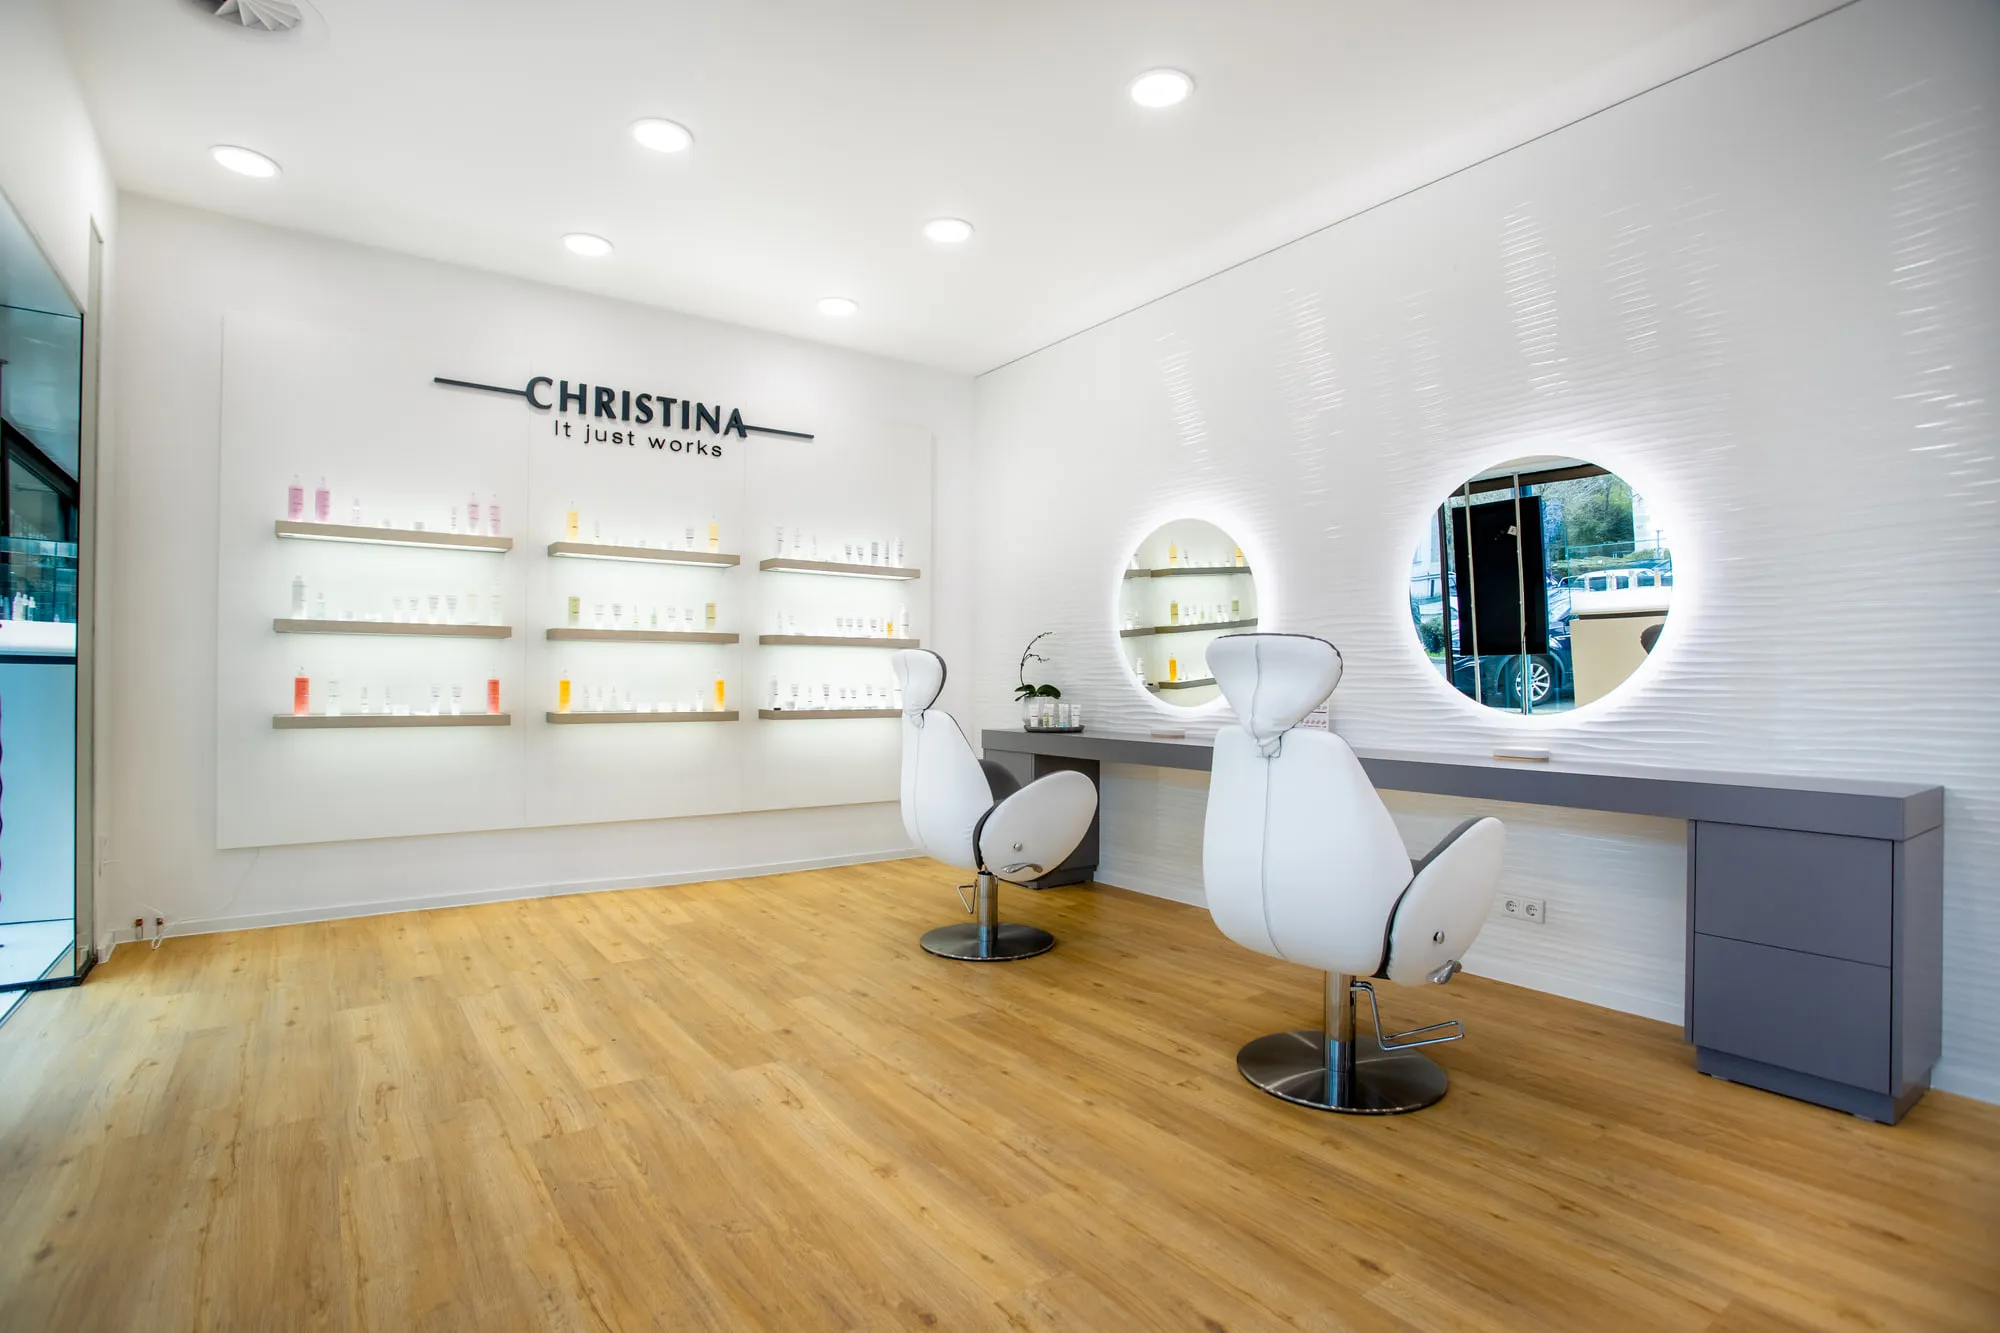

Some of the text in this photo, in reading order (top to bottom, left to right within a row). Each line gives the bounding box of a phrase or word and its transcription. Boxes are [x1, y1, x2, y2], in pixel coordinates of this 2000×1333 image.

[526, 376, 747, 439] CHRISTINA
[554, 419, 723, 458] It just works
